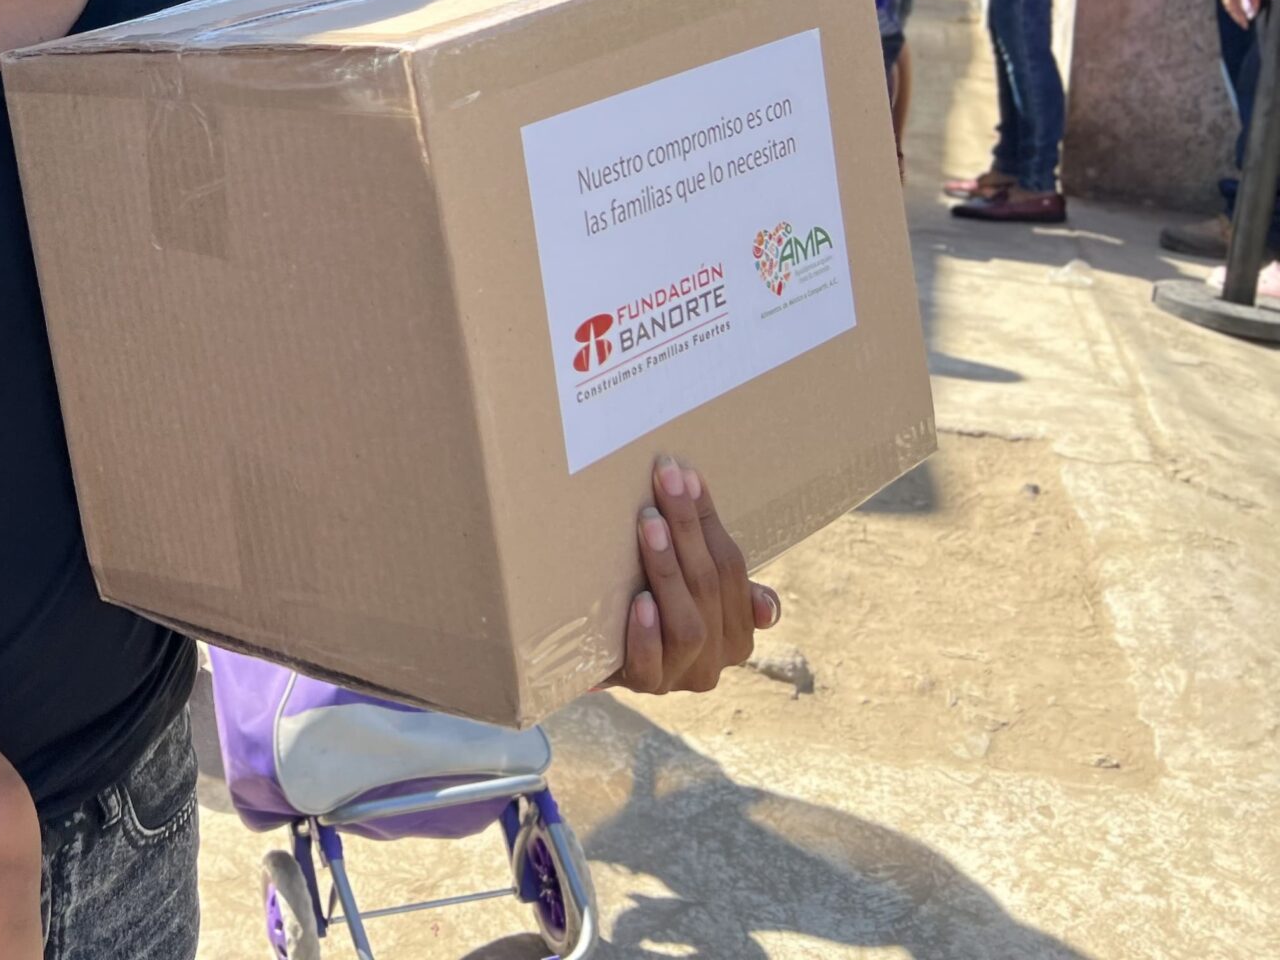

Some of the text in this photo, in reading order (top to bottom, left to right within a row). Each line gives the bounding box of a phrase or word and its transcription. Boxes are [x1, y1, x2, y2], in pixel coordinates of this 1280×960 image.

[577, 98, 793, 195] Nuestro compromiso es con
[584, 136, 797, 236] las familias que lo necesitan
[778, 226, 833, 273] AMA
[616, 262, 724, 325] FUNDACIÓN
[619, 284, 727, 353] BANORTE
[576, 321, 731, 403] Construimos Familias Fuertes
